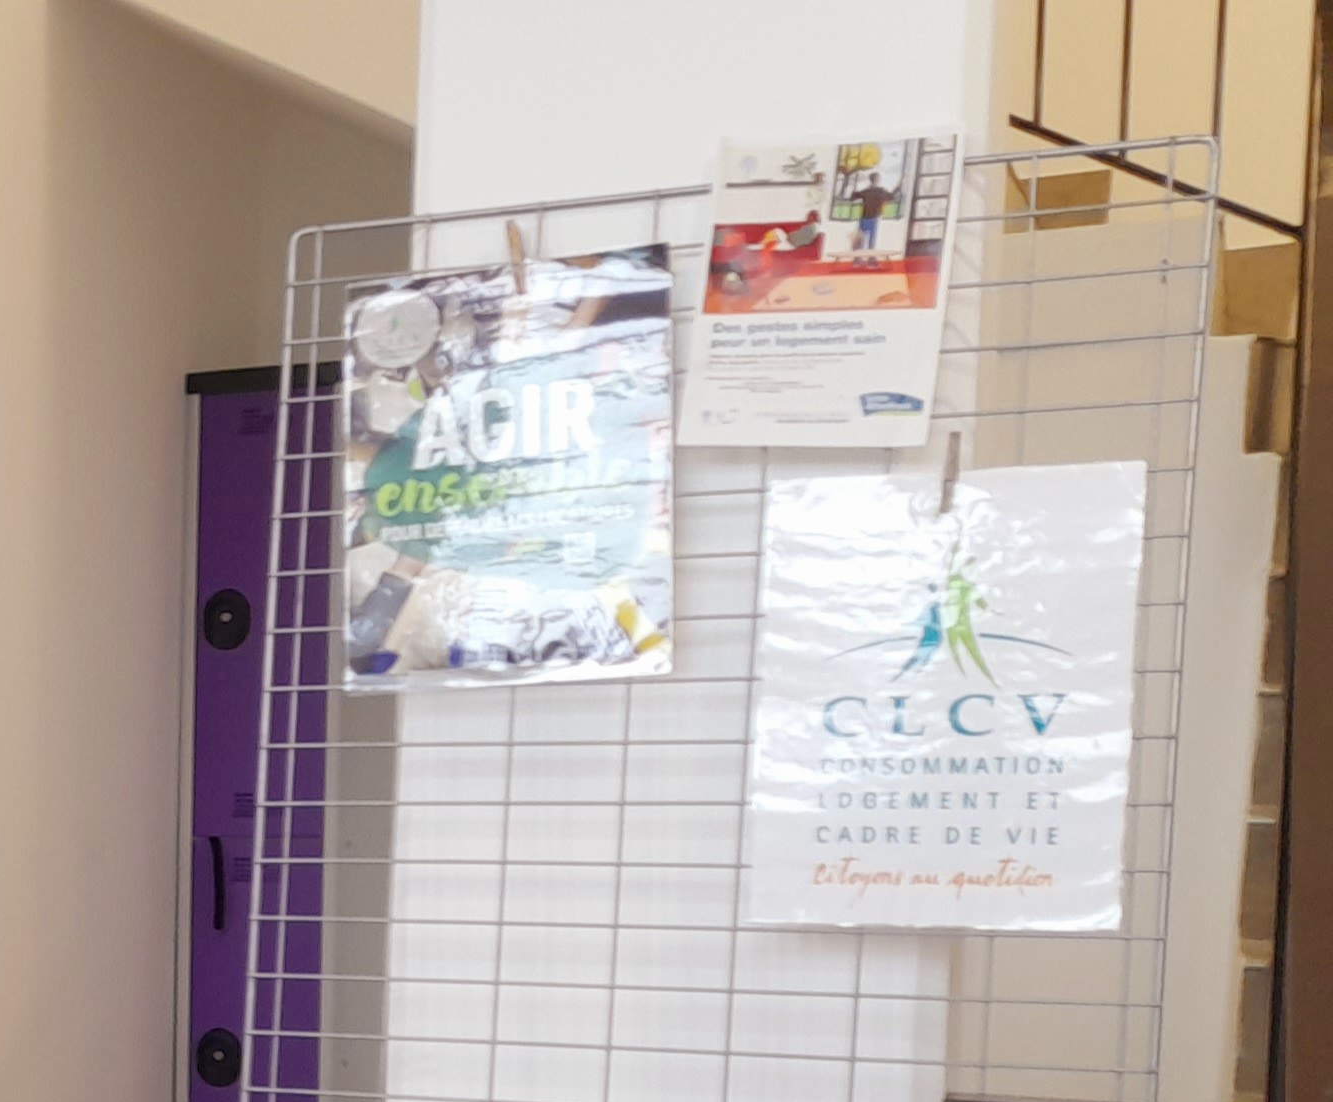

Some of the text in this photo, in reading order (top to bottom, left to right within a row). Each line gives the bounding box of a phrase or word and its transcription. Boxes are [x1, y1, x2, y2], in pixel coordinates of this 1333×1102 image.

[412, 379, 597, 471] AGIR
[823, 693, 1068, 738] CLCV
[821, 756, 1064, 776] CONSOMMATION
[818, 791, 1060, 810] LOGEMENT ET
[816, 825, 1060, 845] CADRE DE VIE
[813, 856, 904, 898] Citoyens
[910, 872, 939, 886] au
